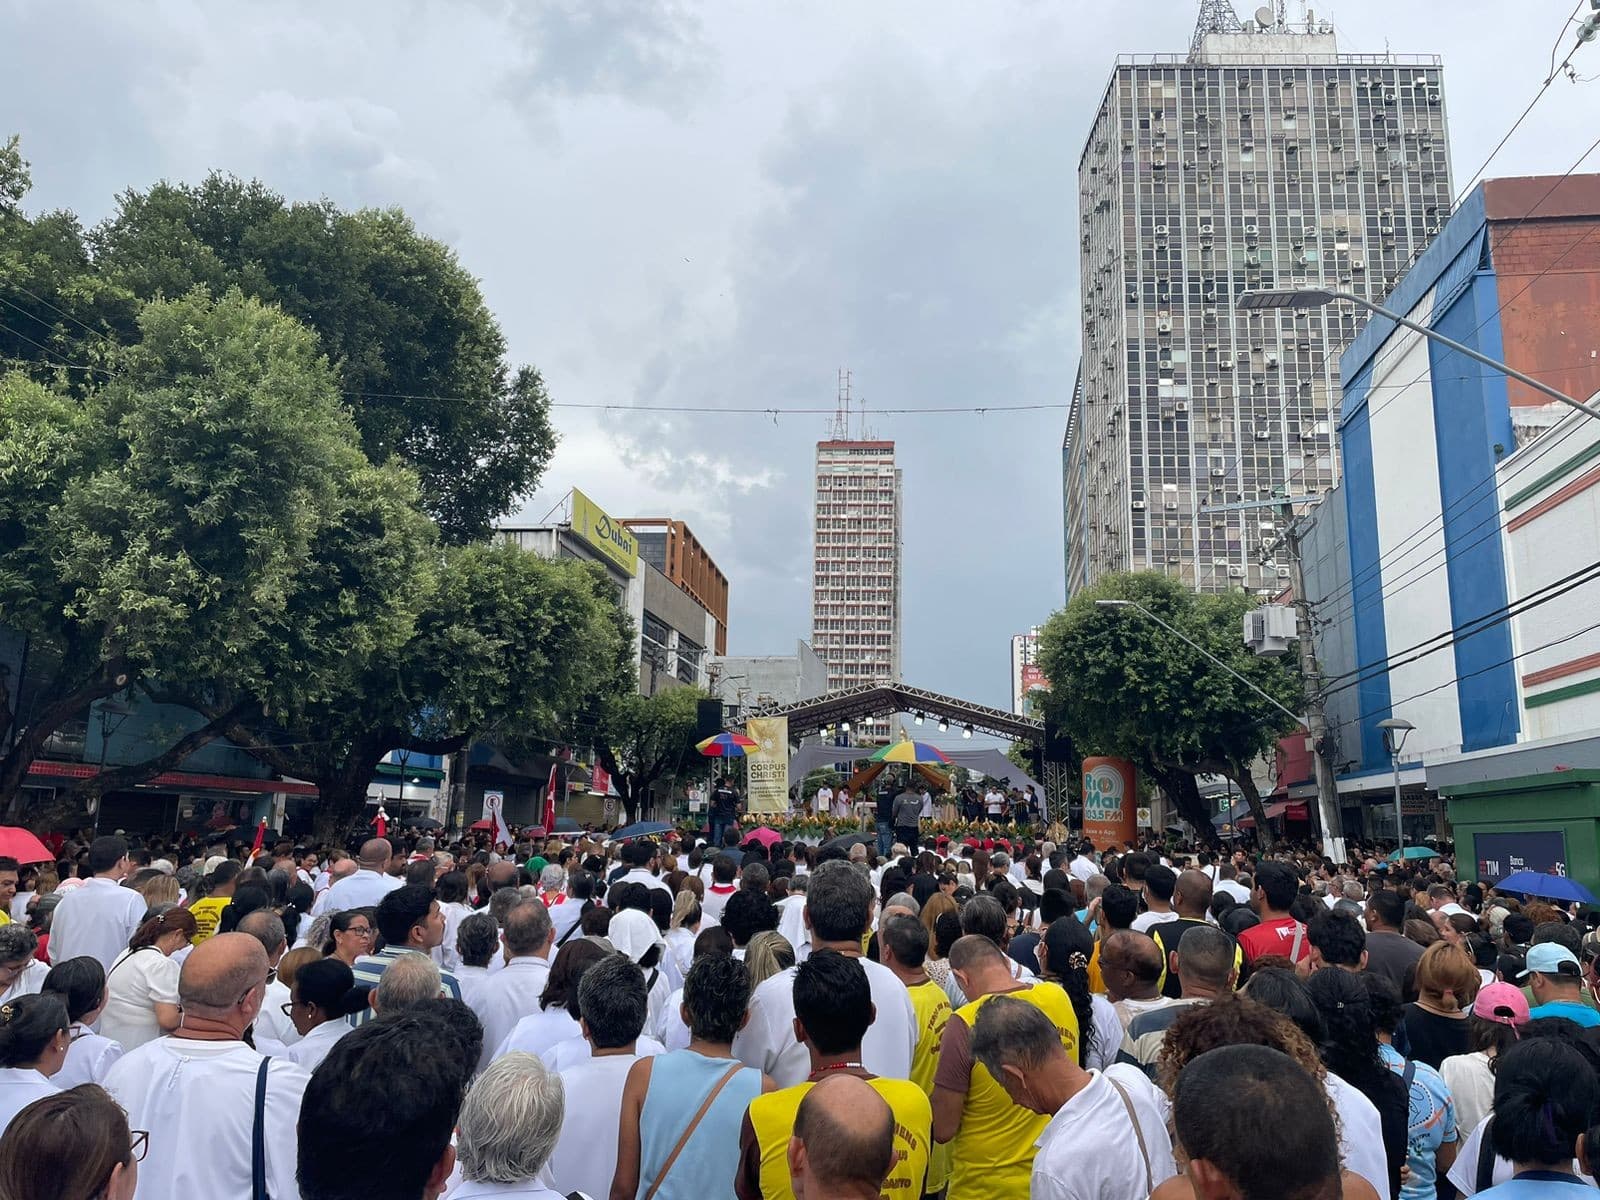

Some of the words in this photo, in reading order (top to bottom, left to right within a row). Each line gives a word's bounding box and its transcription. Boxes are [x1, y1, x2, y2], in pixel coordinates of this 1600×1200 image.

[595, 515, 632, 555] Dubai
[750, 763, 786, 771] CORPUS
[750, 771, 785, 779] CHRISTI
[1085, 791, 1122, 809] Mar
[1104, 810, 1123, 821] FM
[1509, 855, 1524, 866] Banco
[1486, 860, 1499, 876] TIM
[1555, 861, 1566, 878] 5G
